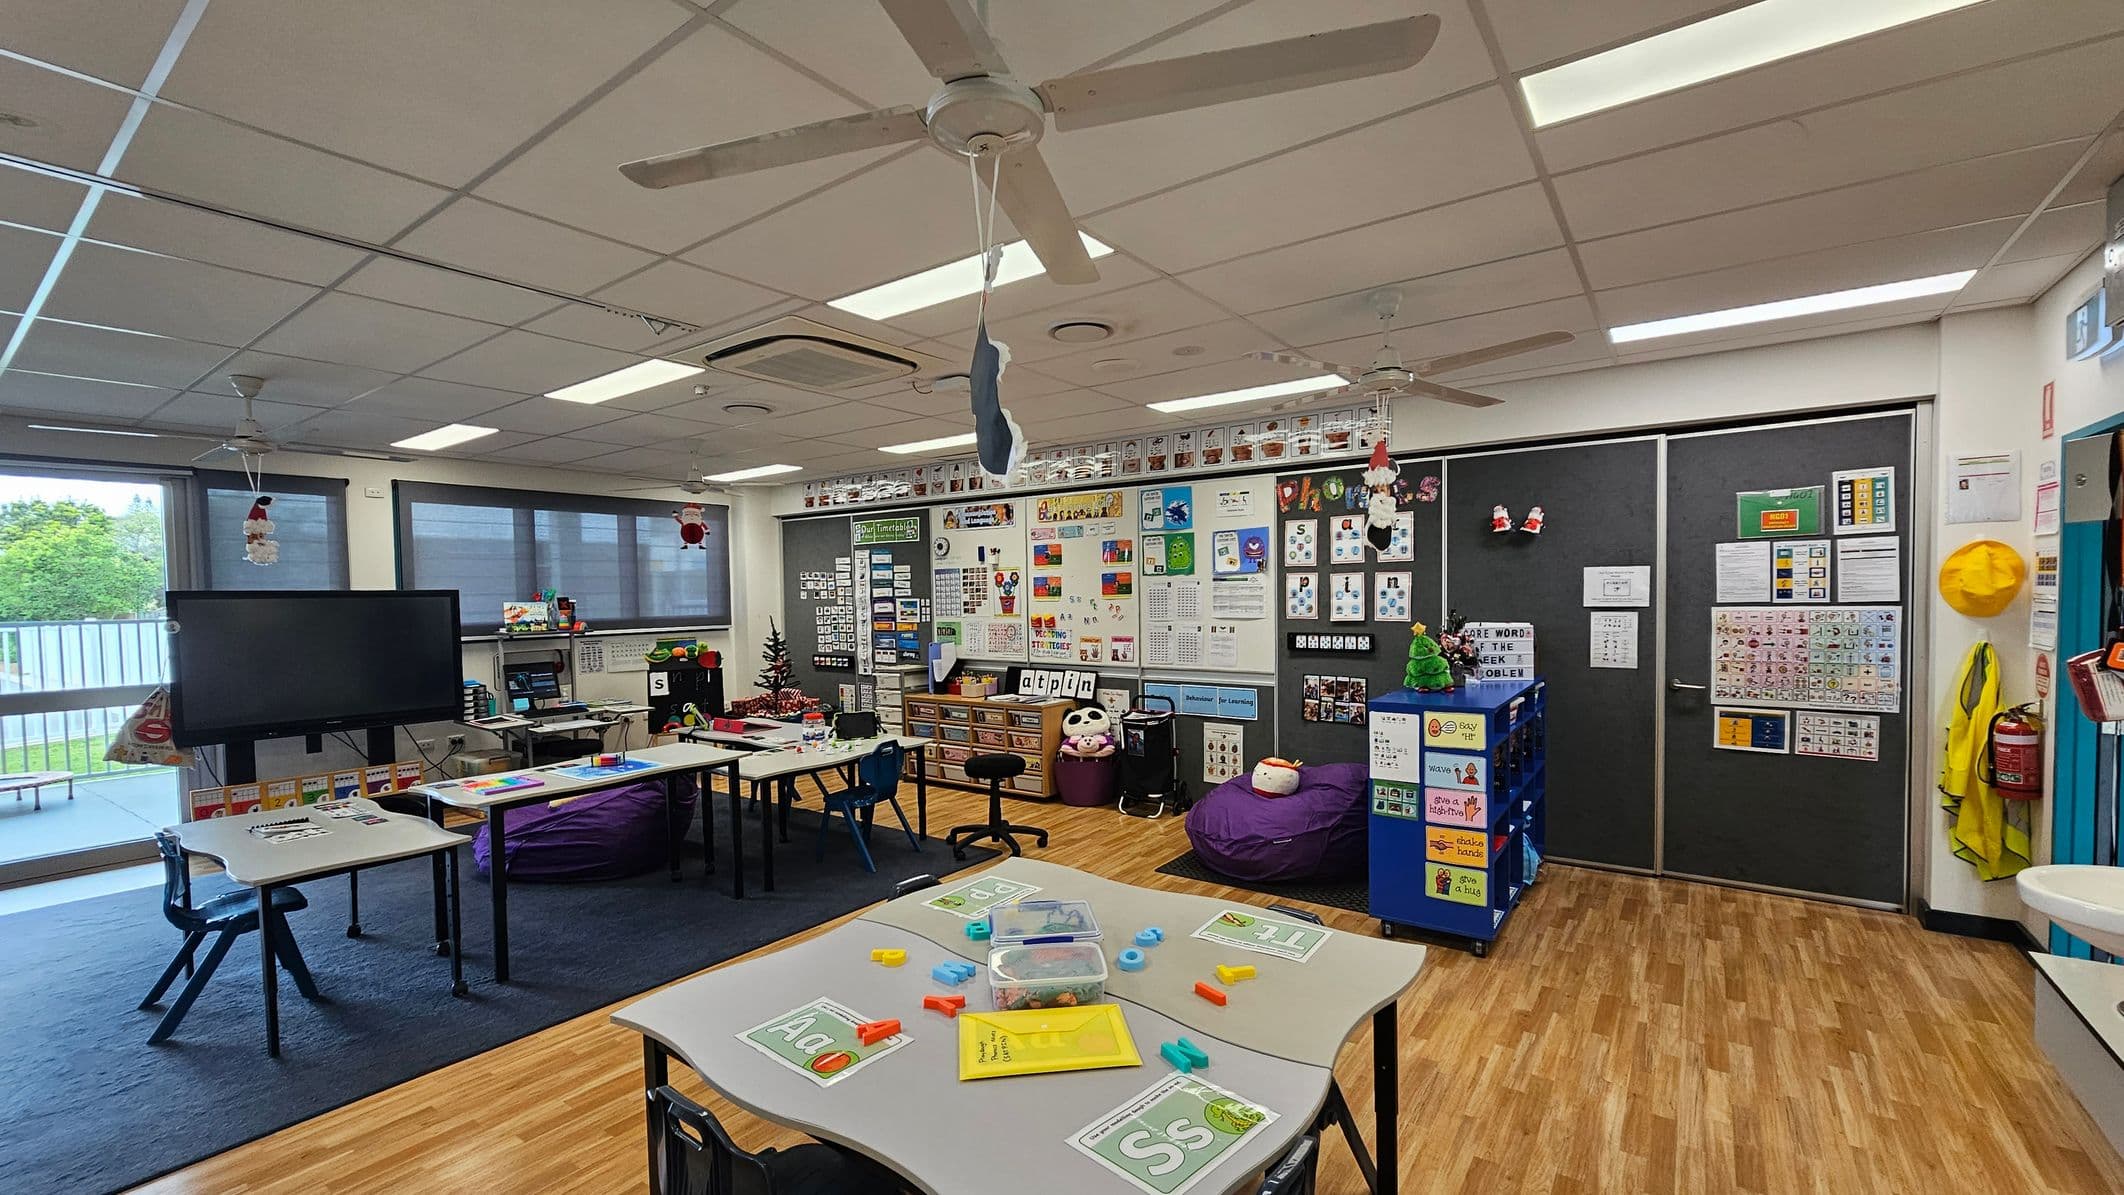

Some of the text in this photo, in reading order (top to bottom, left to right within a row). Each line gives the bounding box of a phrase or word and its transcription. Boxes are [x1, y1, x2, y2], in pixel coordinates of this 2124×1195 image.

[876, 523, 907, 533] Timetabl
[1035, 629, 1067, 639] DECODING
[1496, 628, 1525, 638] WORD
[1031, 640, 1072, 651] STRATEGIES
[1492, 642, 1514, 652] THE
[1483, 656, 1505, 665] EEK
[1218, 697, 1227, 705] for
[1228, 697, 1254, 706] Learning
[1428, 764, 1452, 774] wave
[1433, 795, 1451, 805] give
[1456, 836, 1484, 848] shake
[1457, 847, 1484, 859] hands
[1459, 874, 1477, 885] give
[1464, 884, 1481, 898] hug
